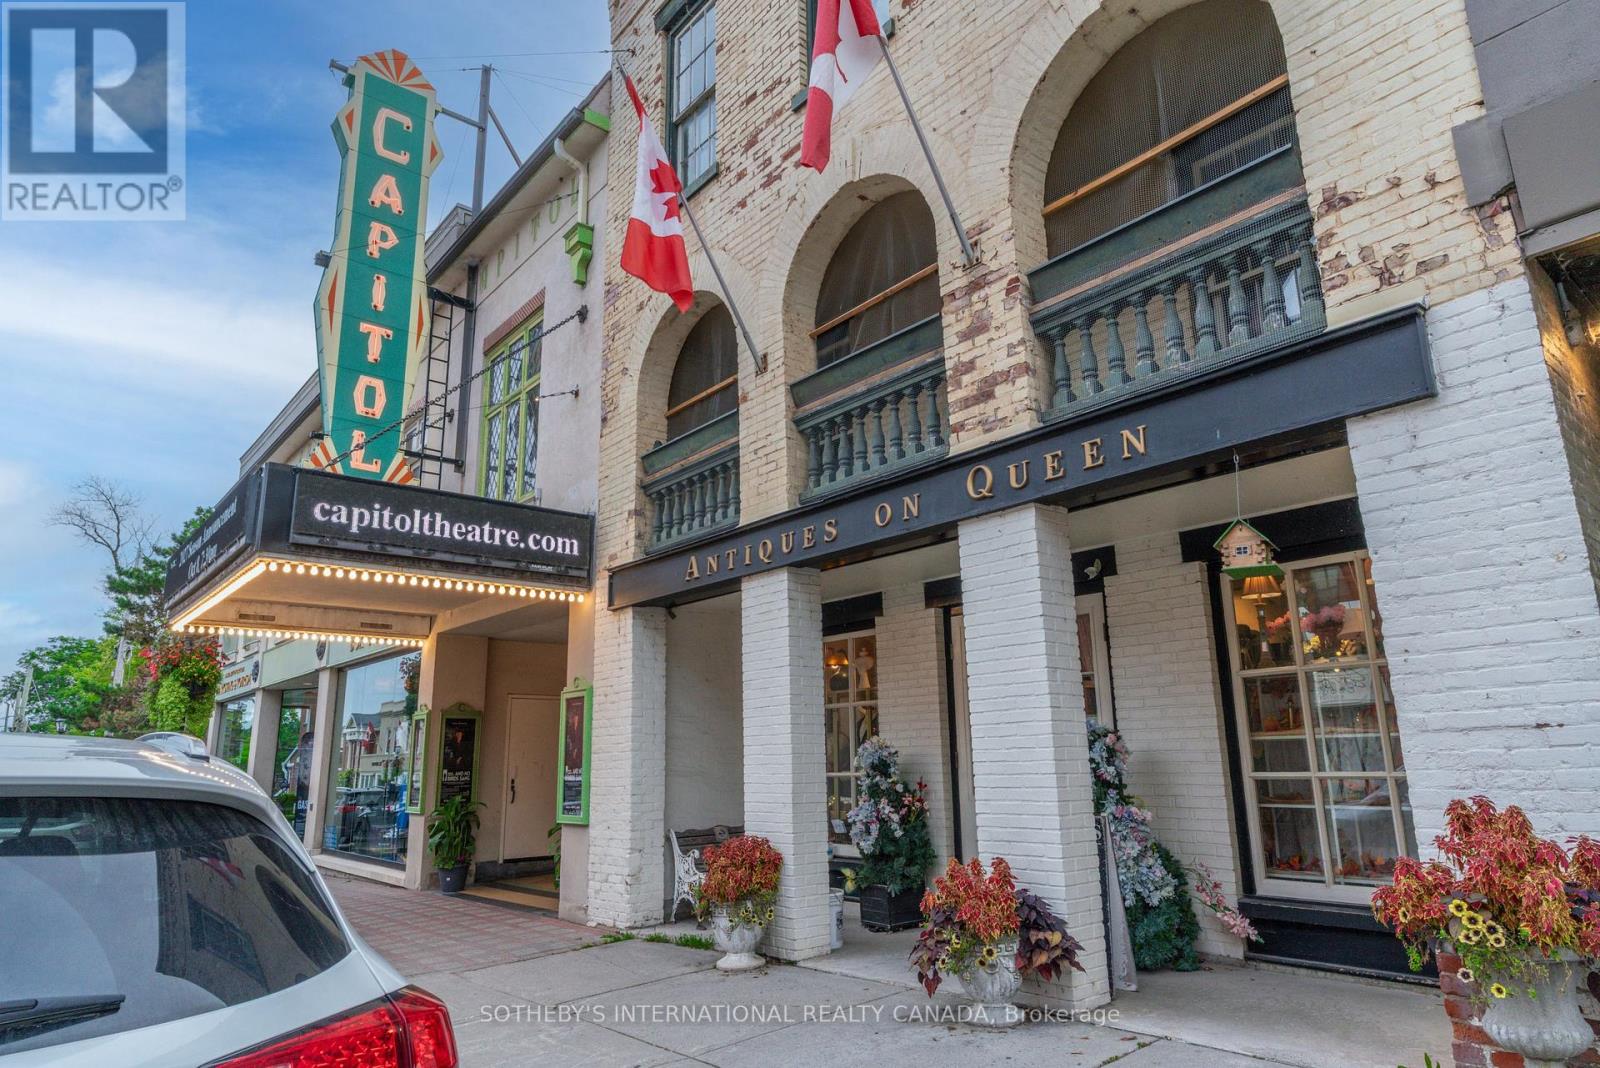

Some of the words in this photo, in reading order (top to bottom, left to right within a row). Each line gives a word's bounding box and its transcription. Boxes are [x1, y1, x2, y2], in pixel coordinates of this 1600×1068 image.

[351, 107, 413, 473] CAPITOL
[313, 502, 580, 556] capitoltheatre.com
[684, 518, 839, 582] ANTIQUES
[875, 493, 920, 528] ON
[966, 424, 1148, 499] QUEEN
